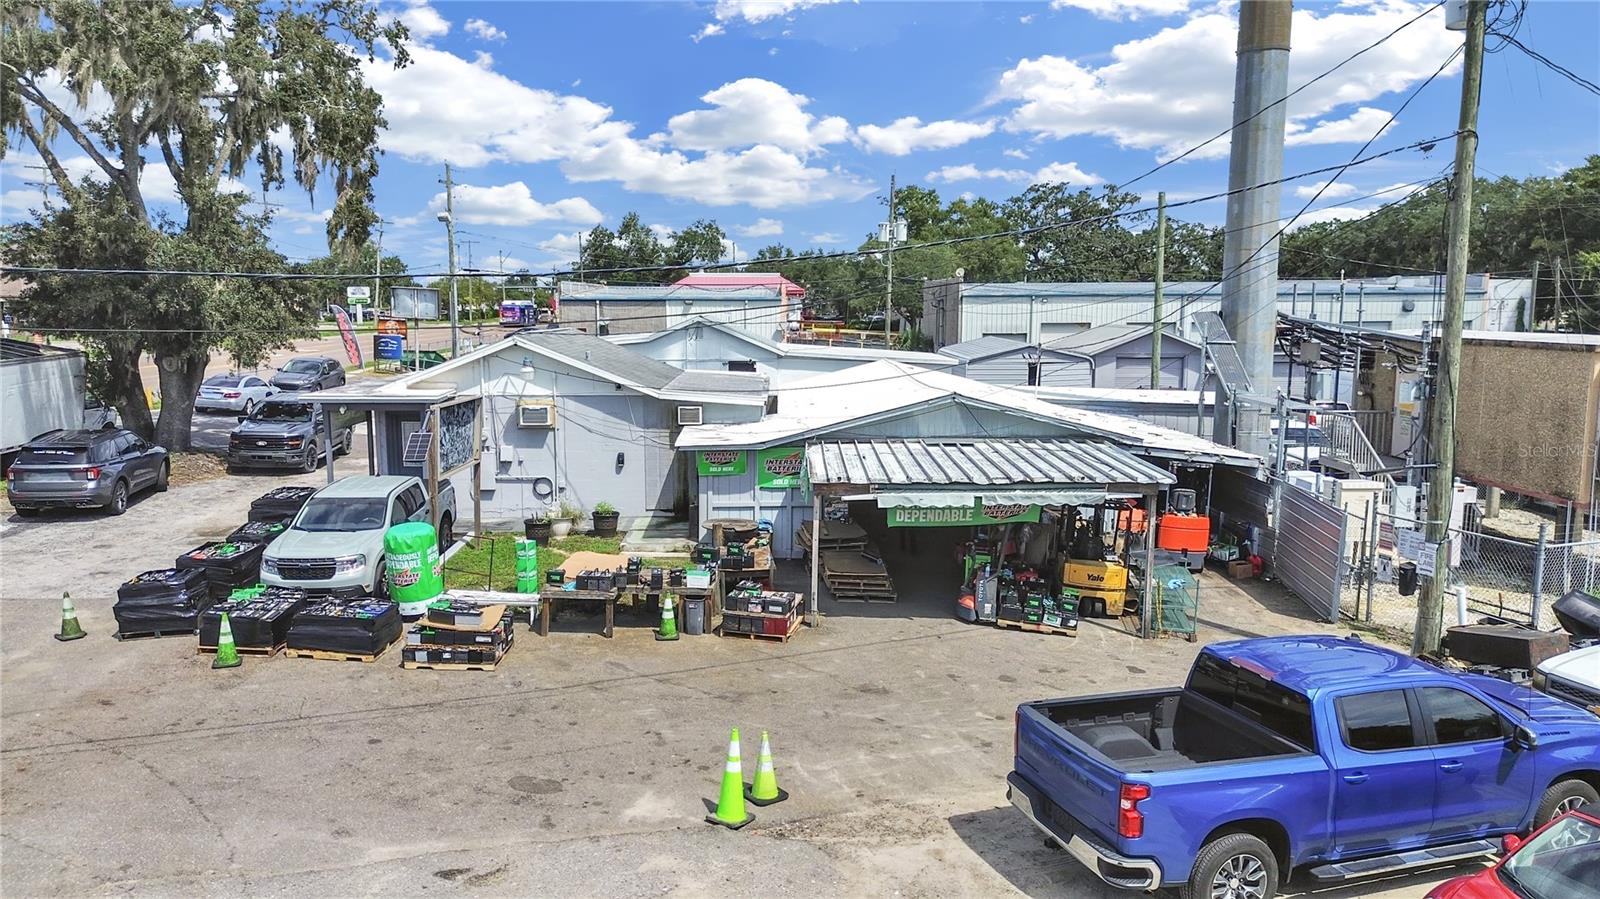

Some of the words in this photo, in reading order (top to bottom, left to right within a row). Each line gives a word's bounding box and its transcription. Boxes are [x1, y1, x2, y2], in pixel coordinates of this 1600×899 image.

[982, 503, 1031, 511] INTERSTATE
[984, 508, 1027, 516] BATTERIES
[895, 509, 974, 522] DEPENDABLE
[1420, 551, 1434, 562] FIRE
[1418, 559, 1434, 569] LANE
[1087, 573, 1105, 583] Yale
